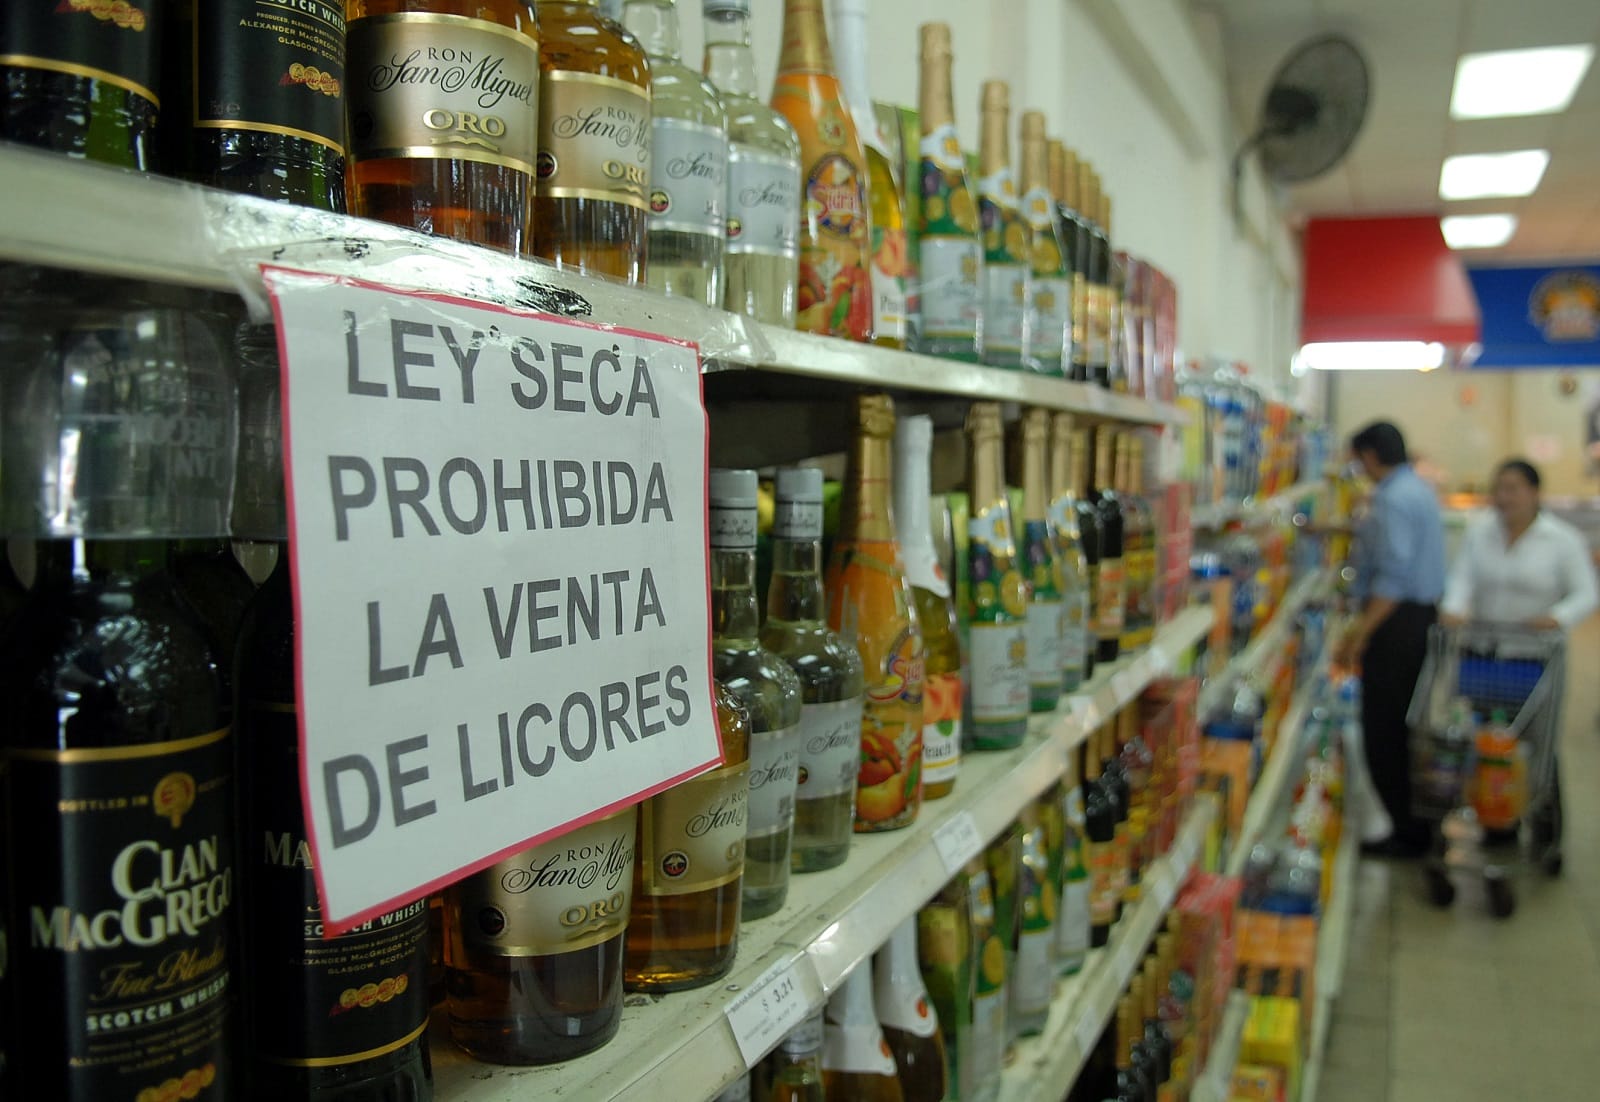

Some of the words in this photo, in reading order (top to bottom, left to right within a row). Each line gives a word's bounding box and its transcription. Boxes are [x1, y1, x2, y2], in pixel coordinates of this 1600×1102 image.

[239, 18, 296, 35] ALEXANDER
[278, 36, 319, 55] GLASGOW,
[428, 46, 473, 64] RON
[368, 49, 441, 92] San
[440, 54, 533, 109] Miguel
[422, 109, 505, 138] ORO
[552, 106, 615, 139] San
[607, 106, 636, 123] RON
[342, 310, 485, 404] LEY
[510, 336, 660, 418] SECA
[328, 455, 673, 542] PROHIBIDA
[367, 593, 464, 686] LA
[483, 567, 667, 660] VENTA
[323, 734, 437, 849] DE
[457, 665, 691, 802] LICORES
[686, 798, 737, 838] San
[111, 835, 219, 902] CLAN
[567, 843, 605, 862] RON
[501, 854, 578, 894] San
[304, 919, 372, 937] SCCH
[380, 899, 426, 928] WHISKY
[559, 892, 625, 927] ORO
[773, 976, 794, 1004] 3.21
[86, 1001, 174, 1034] SCOTCH
